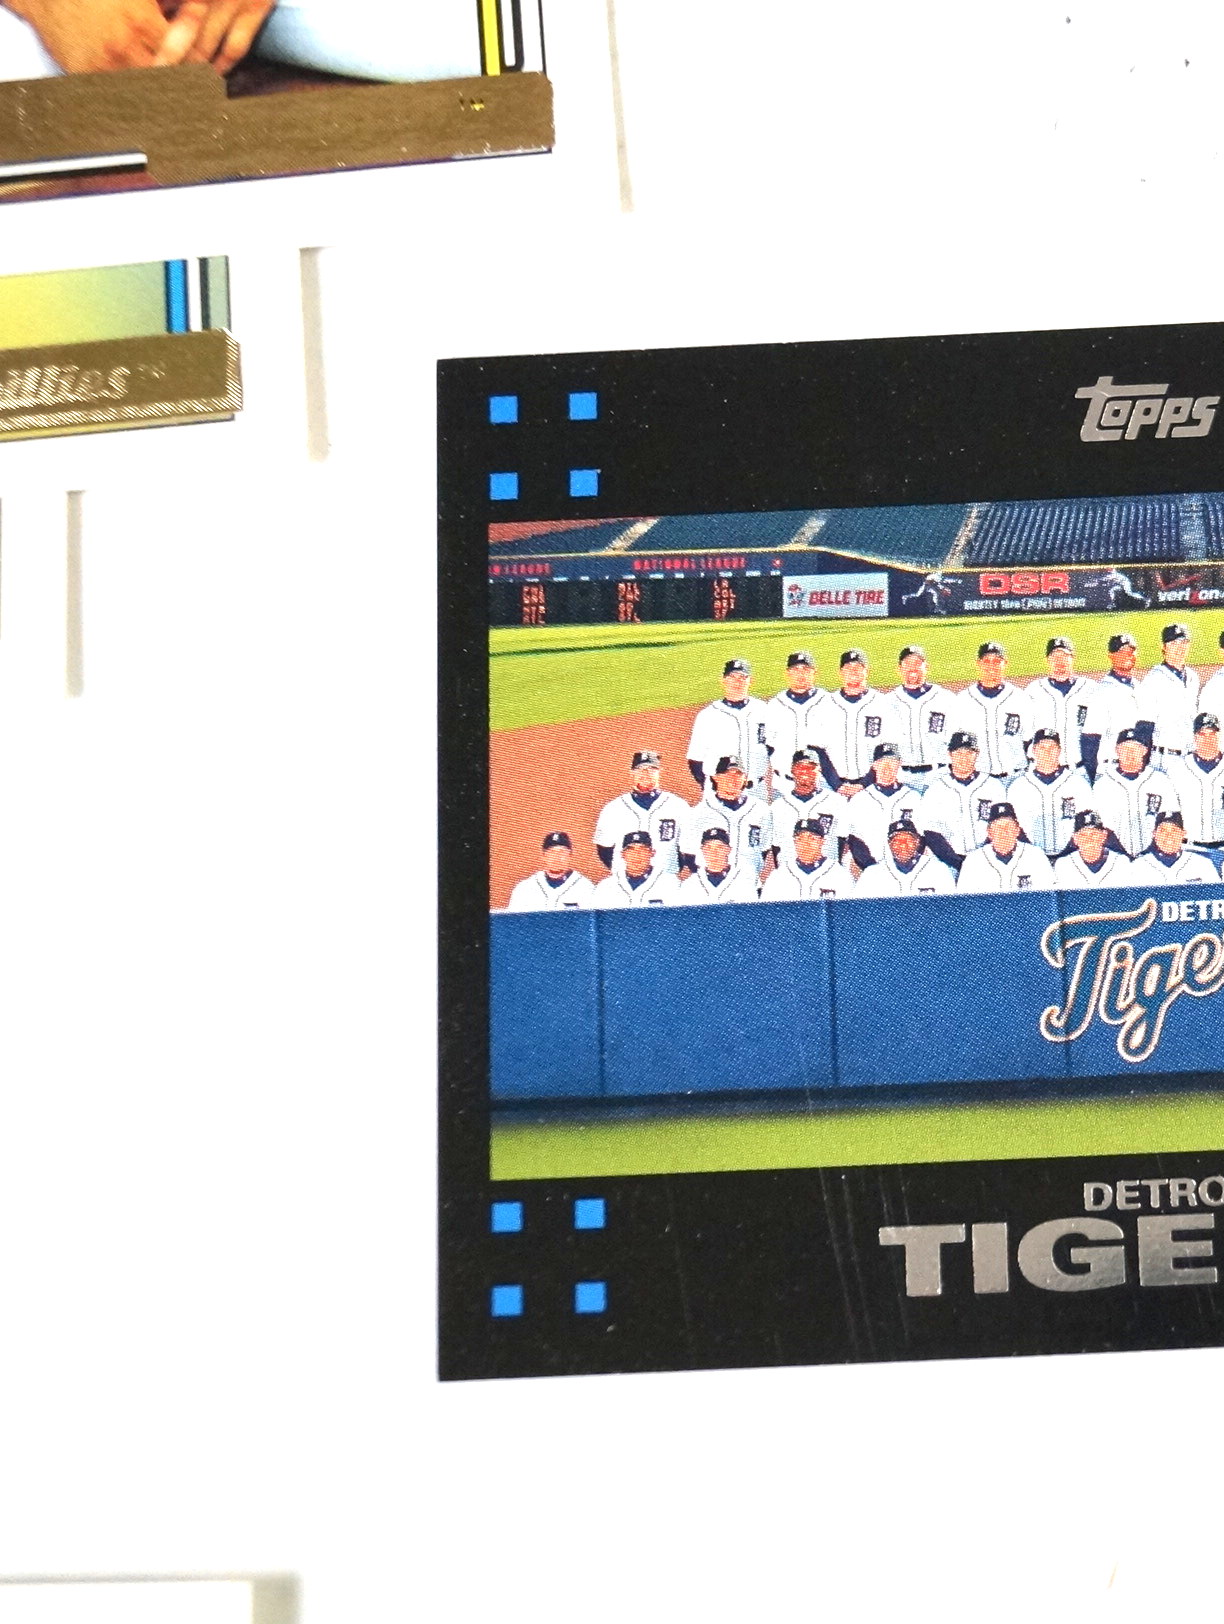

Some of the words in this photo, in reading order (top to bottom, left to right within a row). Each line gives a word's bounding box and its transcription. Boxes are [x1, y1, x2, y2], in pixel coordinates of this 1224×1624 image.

[979, 572, 1070, 596] DSR
[808, 590, 851, 605] BELLE
[855, 589, 885, 605] TIRE
